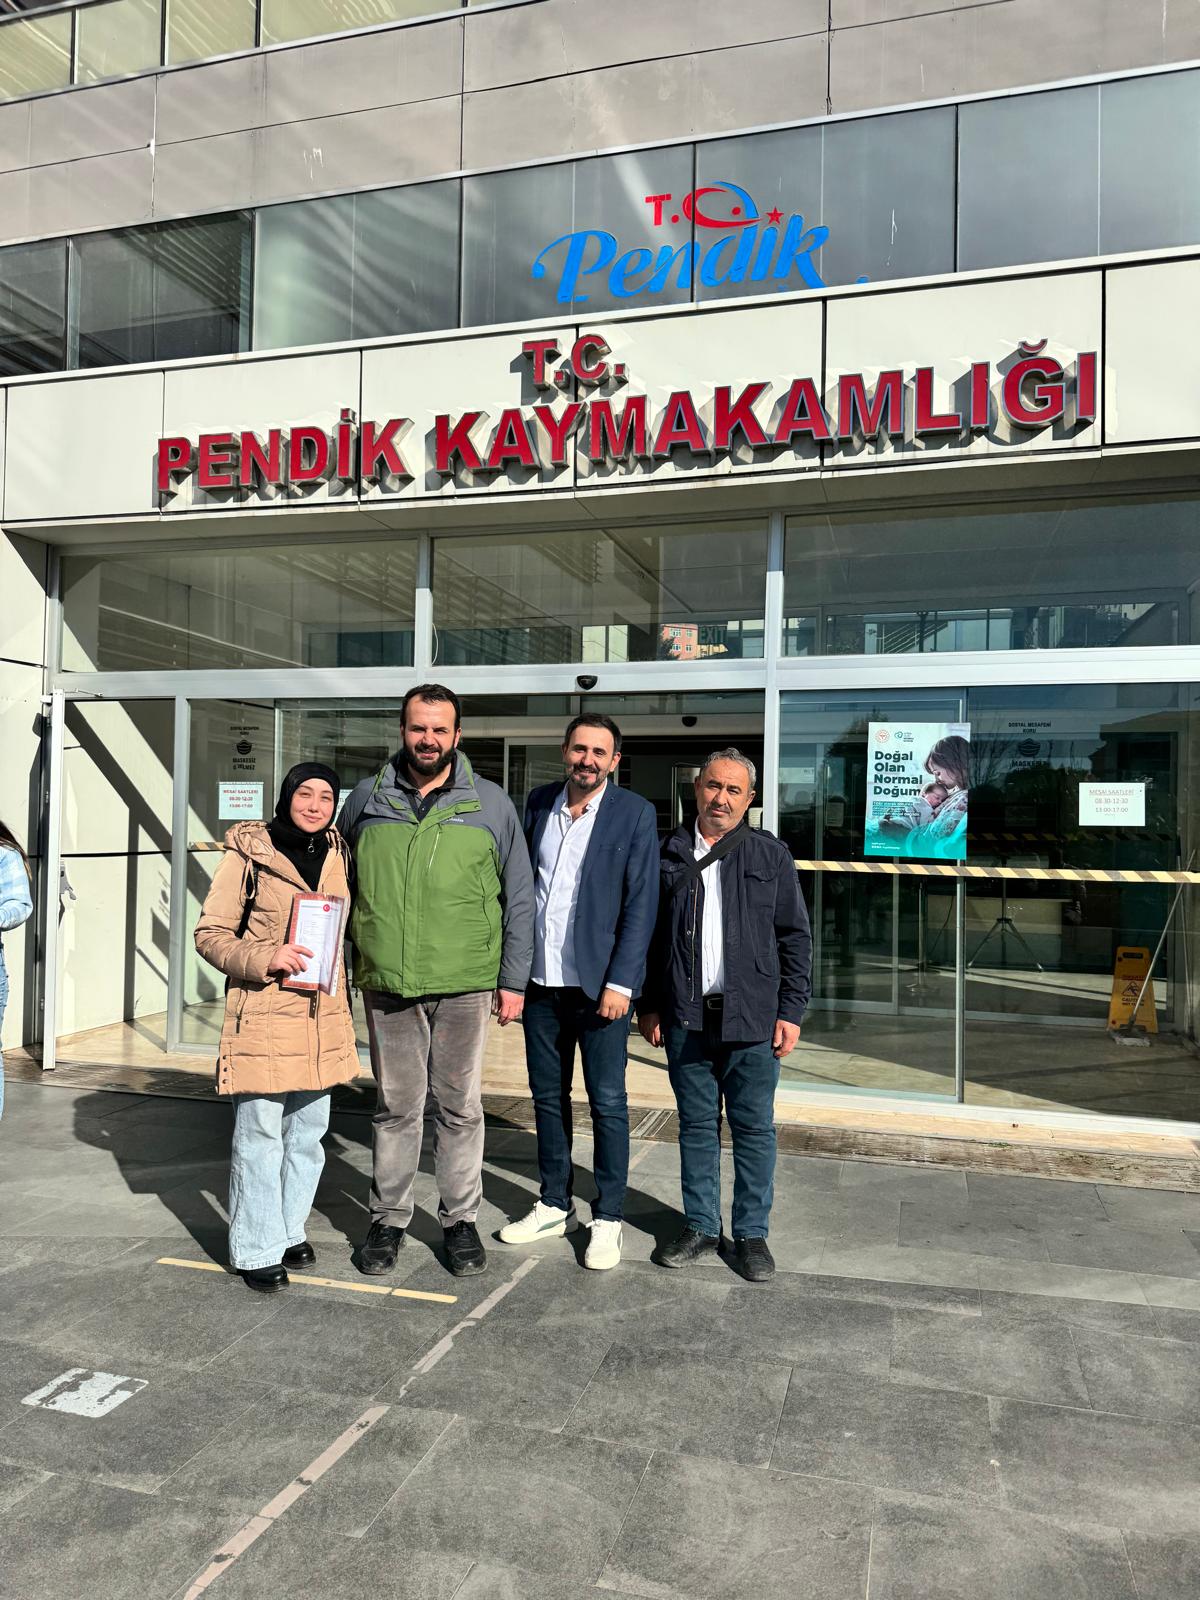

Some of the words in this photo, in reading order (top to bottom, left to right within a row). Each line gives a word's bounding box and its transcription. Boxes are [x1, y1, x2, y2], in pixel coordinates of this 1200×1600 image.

[531, 213, 829, 304] Pendik
[522, 334, 628, 390] T.C.
[158, 407, 413, 492] PENDİK
[435, 339, 1098, 474] KAYMAKAMLIĞI
[701, 627, 726, 643] EXIT
[874, 750, 913, 763] Doğal
[874, 762, 906, 773] Olan
[873, 774, 923, 785] Normal
[873, 786, 921, 798] Doğum
